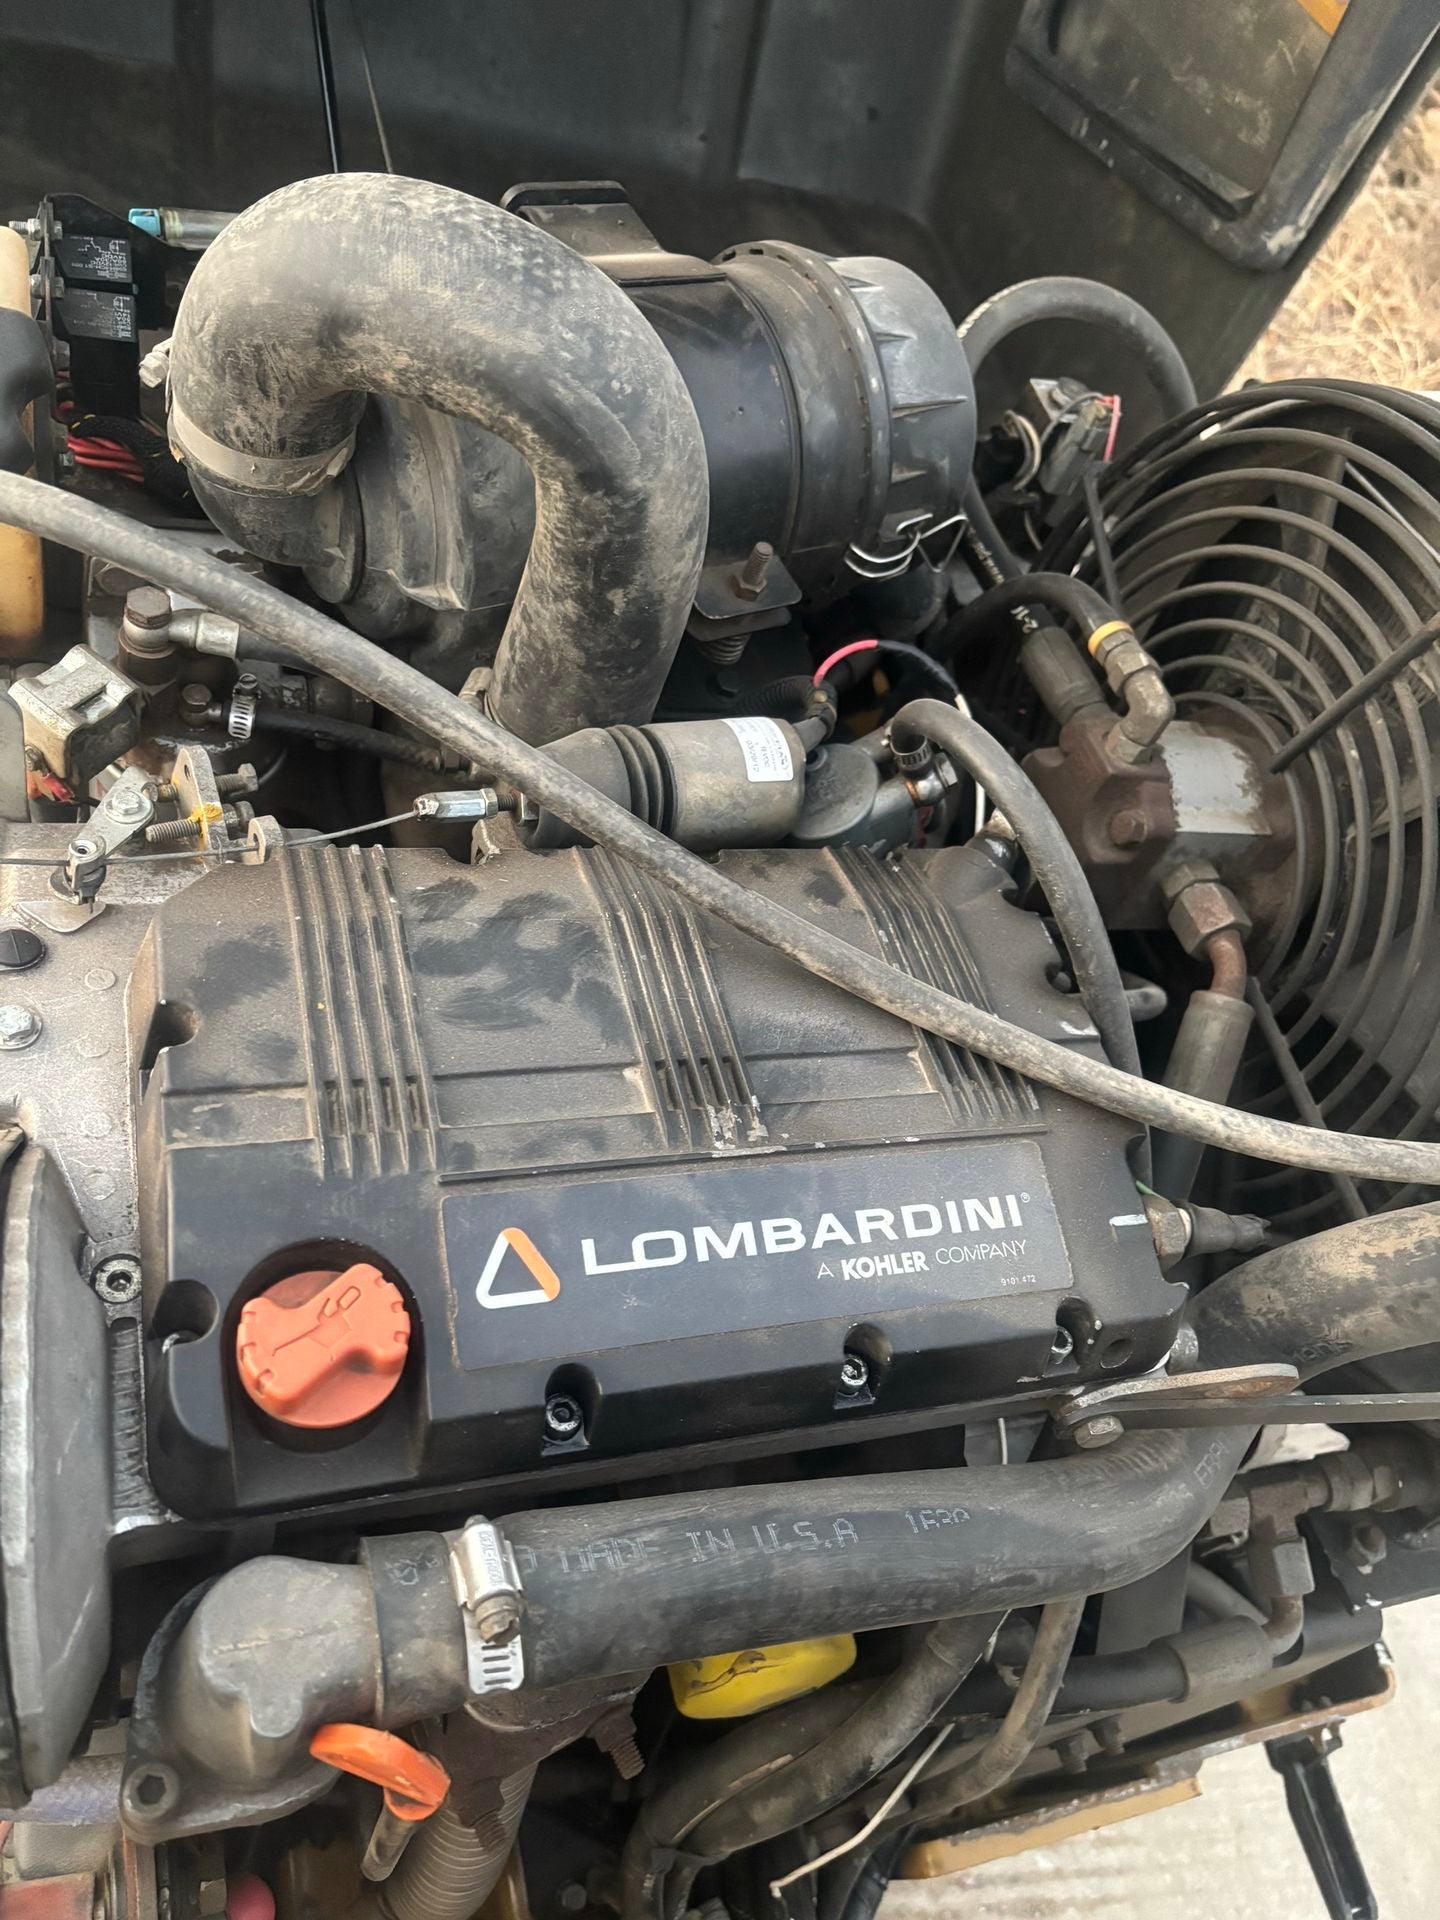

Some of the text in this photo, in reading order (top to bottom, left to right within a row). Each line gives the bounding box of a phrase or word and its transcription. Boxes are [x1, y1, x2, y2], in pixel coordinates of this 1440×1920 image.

[581, 1194, 1024, 1275] LOMBARDINI
[817, 1239, 1027, 1281] A KOHLER COMPANY
[685, 1527, 736, 1563] IN
